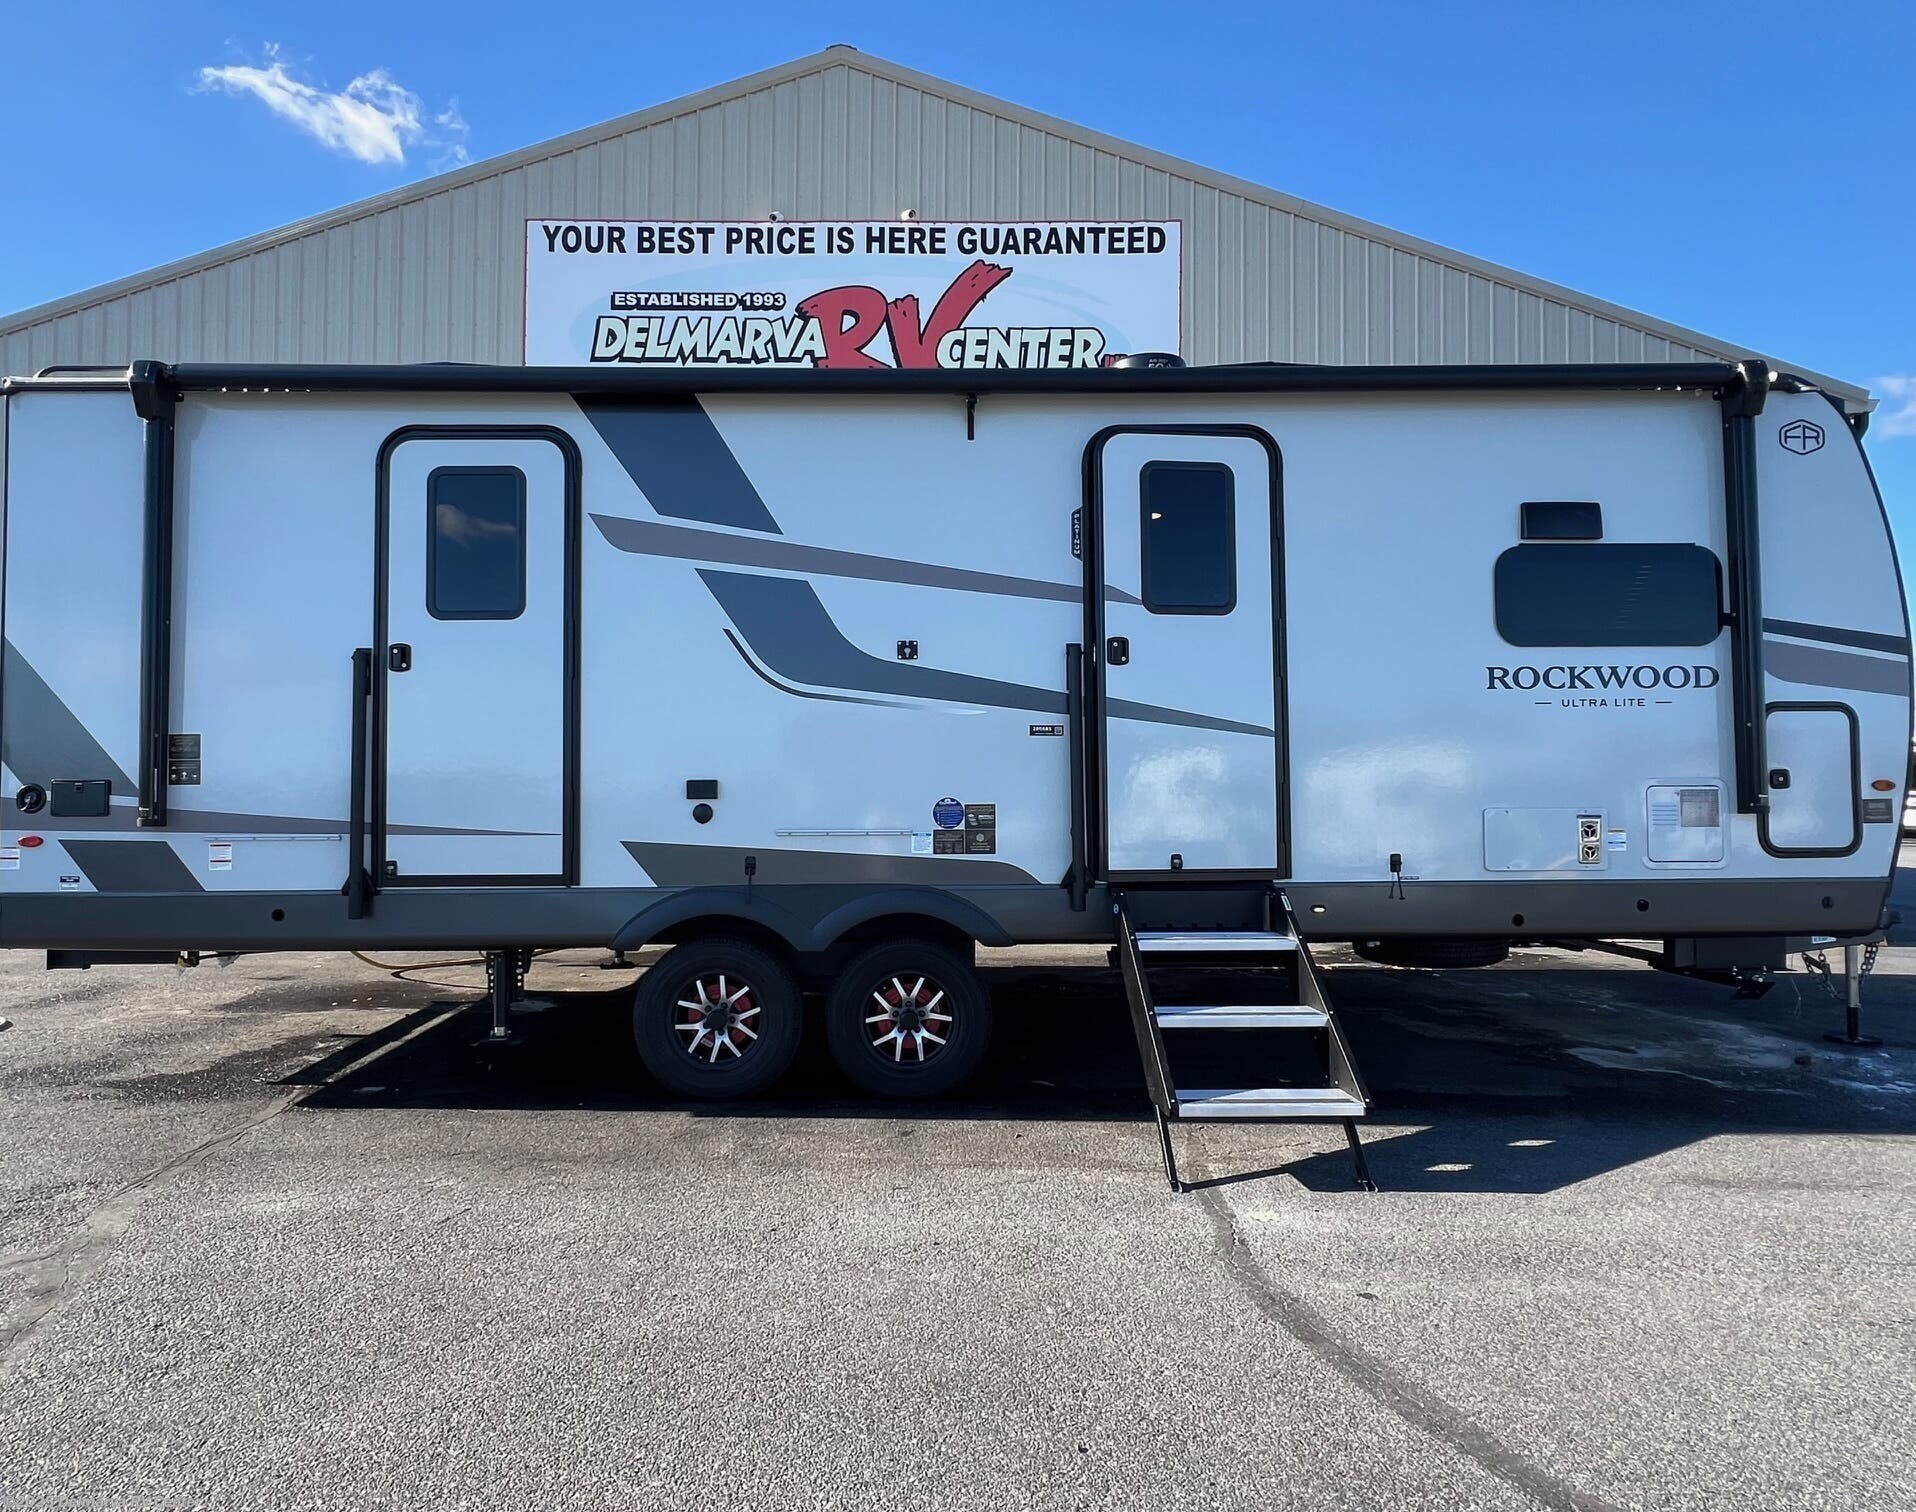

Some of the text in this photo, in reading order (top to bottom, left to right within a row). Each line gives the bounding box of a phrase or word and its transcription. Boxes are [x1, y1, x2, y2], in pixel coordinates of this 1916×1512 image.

[542, 225, 1167, 255] YOUR BEST PRICE IS HERE GUARANTEED
[592, 260, 1105, 368] DELMARVA RV CENTER
[613, 293, 786, 308] ESTABLISHED 1993
[1073, 513, 1081, 555] PLATINUM
[1486, 665, 1720, 690] ROCKWOOD
[1561, 698, 1646, 708] ULTRA LITE
